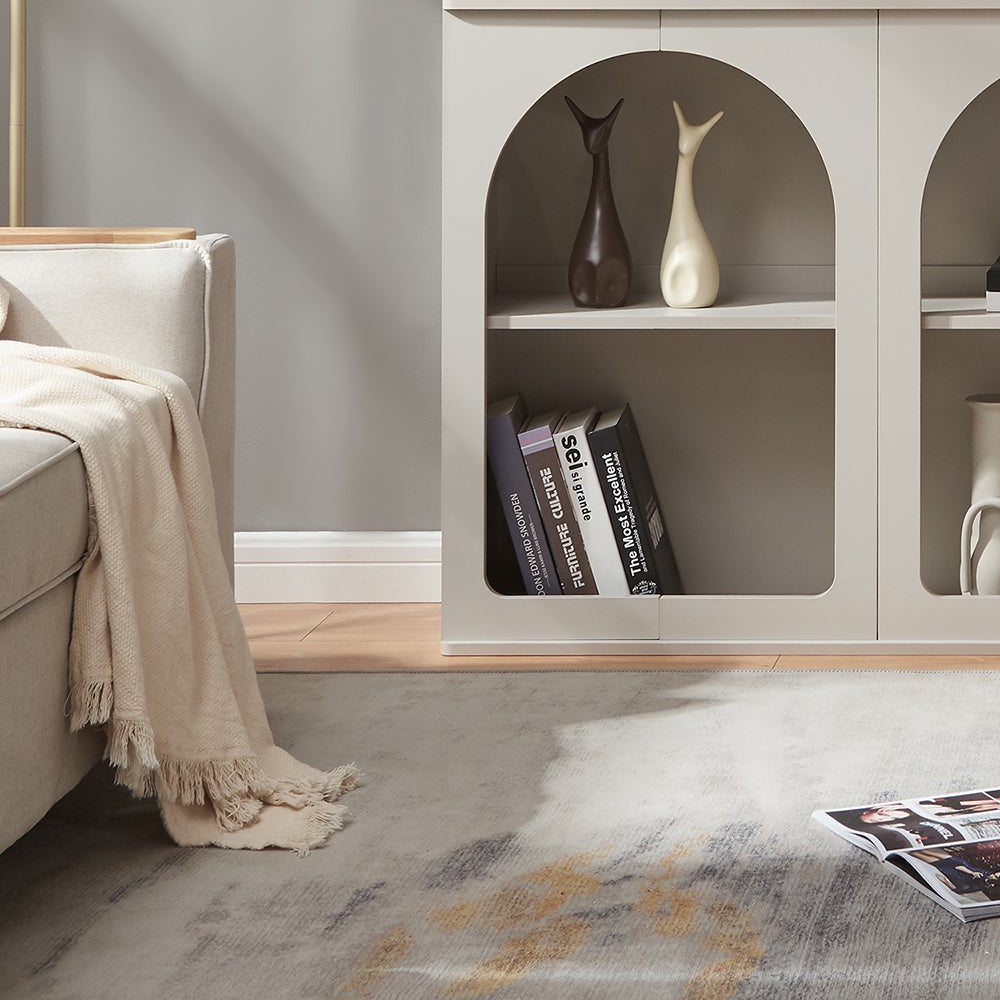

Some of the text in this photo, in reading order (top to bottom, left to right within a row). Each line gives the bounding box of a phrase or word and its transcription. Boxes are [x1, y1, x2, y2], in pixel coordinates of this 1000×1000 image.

[561, 434, 592, 520] sei si grande
[509, 493, 530, 538] SNOWDEN
[601, 452, 641, 577] The Most Excellent
[522, 539, 540, 577] EDWARD
